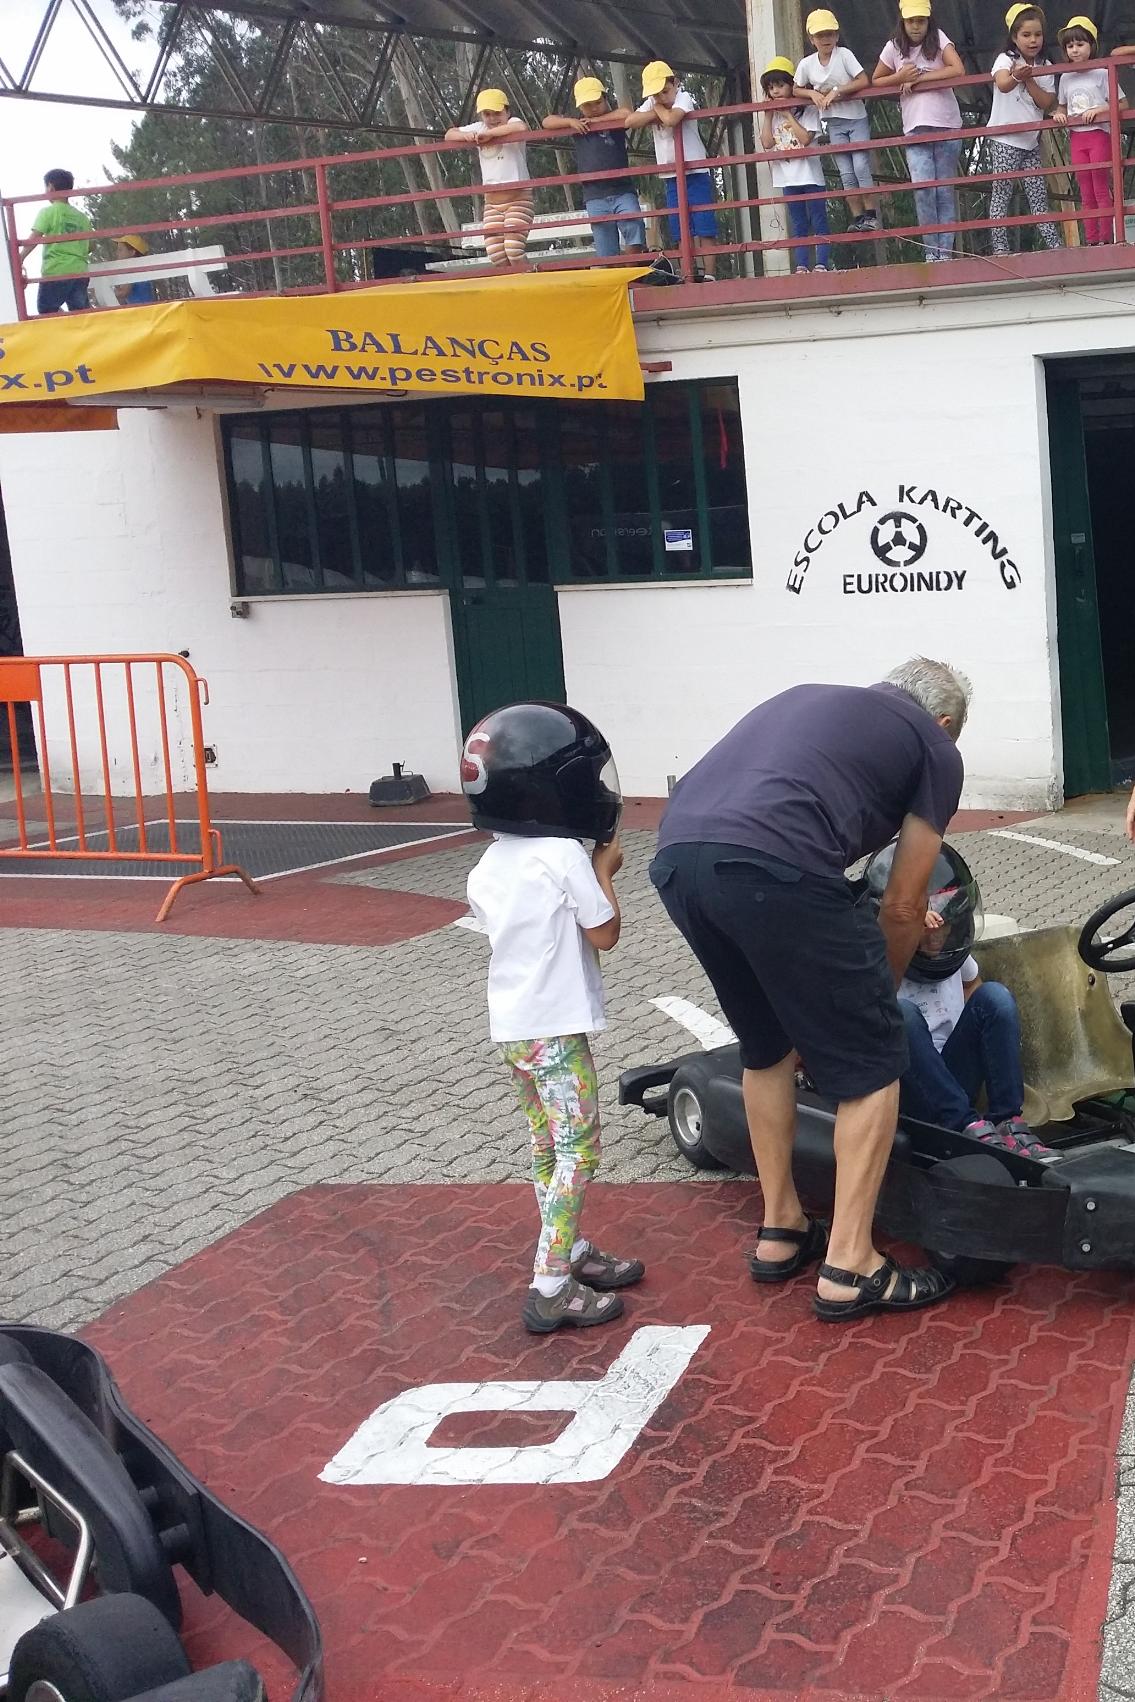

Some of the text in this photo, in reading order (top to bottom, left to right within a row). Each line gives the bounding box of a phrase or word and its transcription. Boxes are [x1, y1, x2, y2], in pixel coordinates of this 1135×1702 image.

[325, 329, 550, 365] BALANÇAS
[786, 484, 1022, 595] ESCOLA KARTING
[843, 570, 967, 594] EUROINDY
